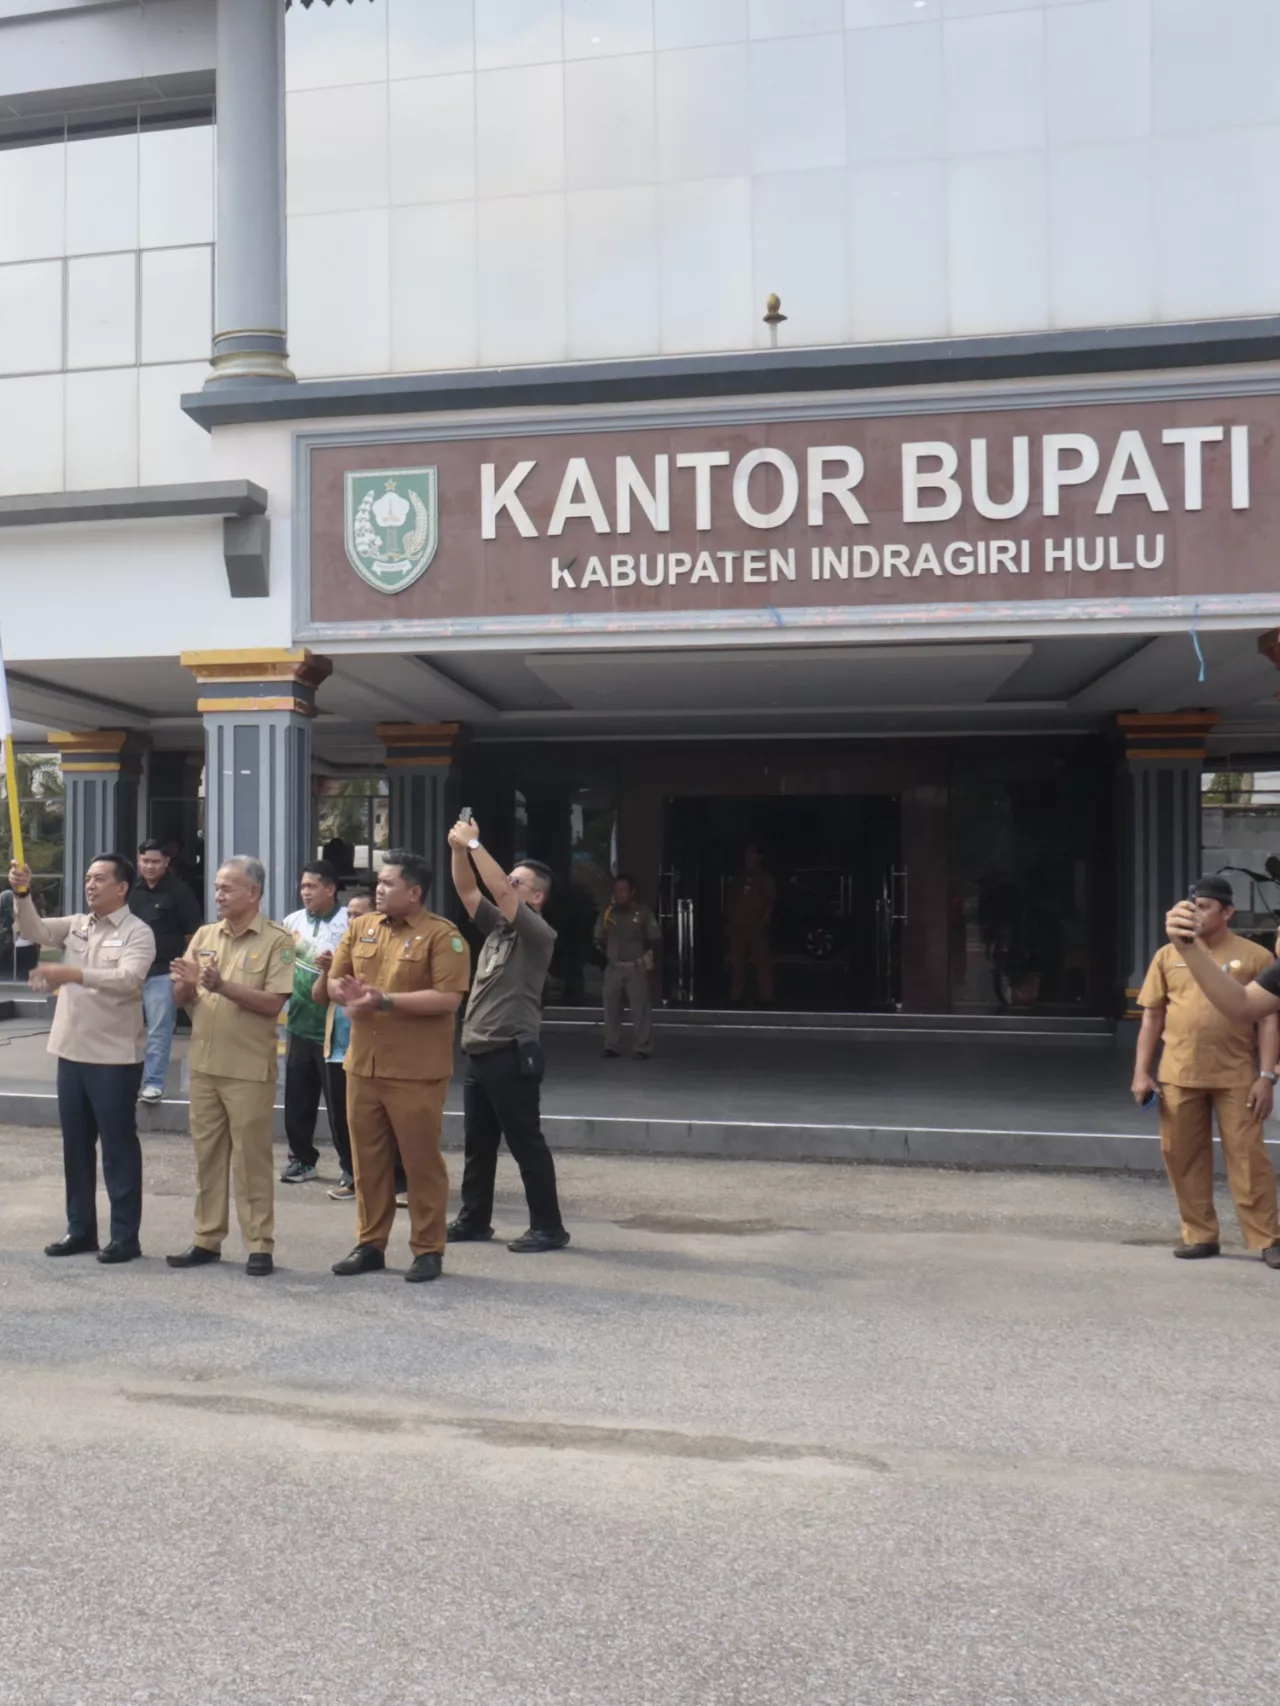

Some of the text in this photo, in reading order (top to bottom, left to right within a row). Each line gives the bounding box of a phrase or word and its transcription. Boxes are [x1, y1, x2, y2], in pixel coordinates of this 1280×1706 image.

[480, 425, 1250, 540] KANTOR BUPATI
[551, 534, 1164, 590] KABUPATEN INDRAGIRI HULU
